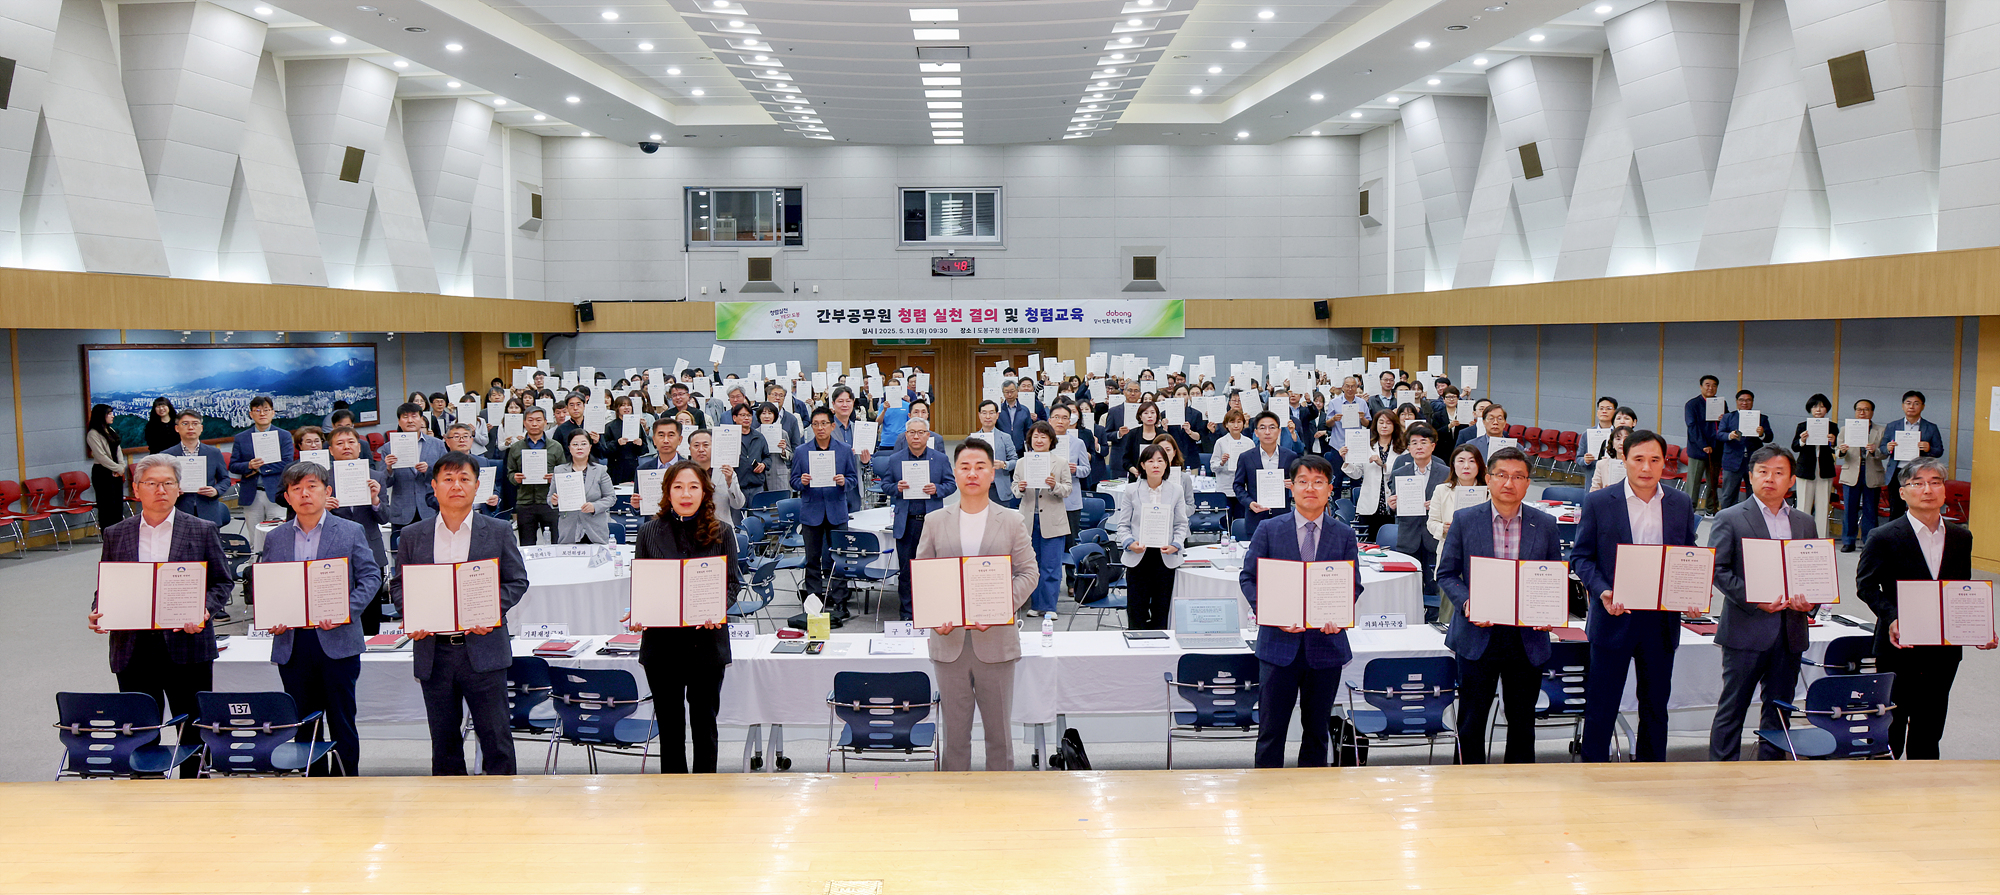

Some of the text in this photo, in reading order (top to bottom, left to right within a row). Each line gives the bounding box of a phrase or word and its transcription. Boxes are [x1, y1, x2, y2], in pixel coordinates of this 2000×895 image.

[816, 308, 892, 324] 간부공무원
[898, 307, 927, 323] 청렴
[933, 307, 963, 323] 실천
[969, 307, 998, 323] 결의
[1004, 308, 1019, 323] 및
[1024, 307, 1084, 323] 청렴교육
[1106, 310, 1132, 318] dobong
[1364, 620, 1403, 628] 의회사무국장
[231, 704, 249, 714] 137
